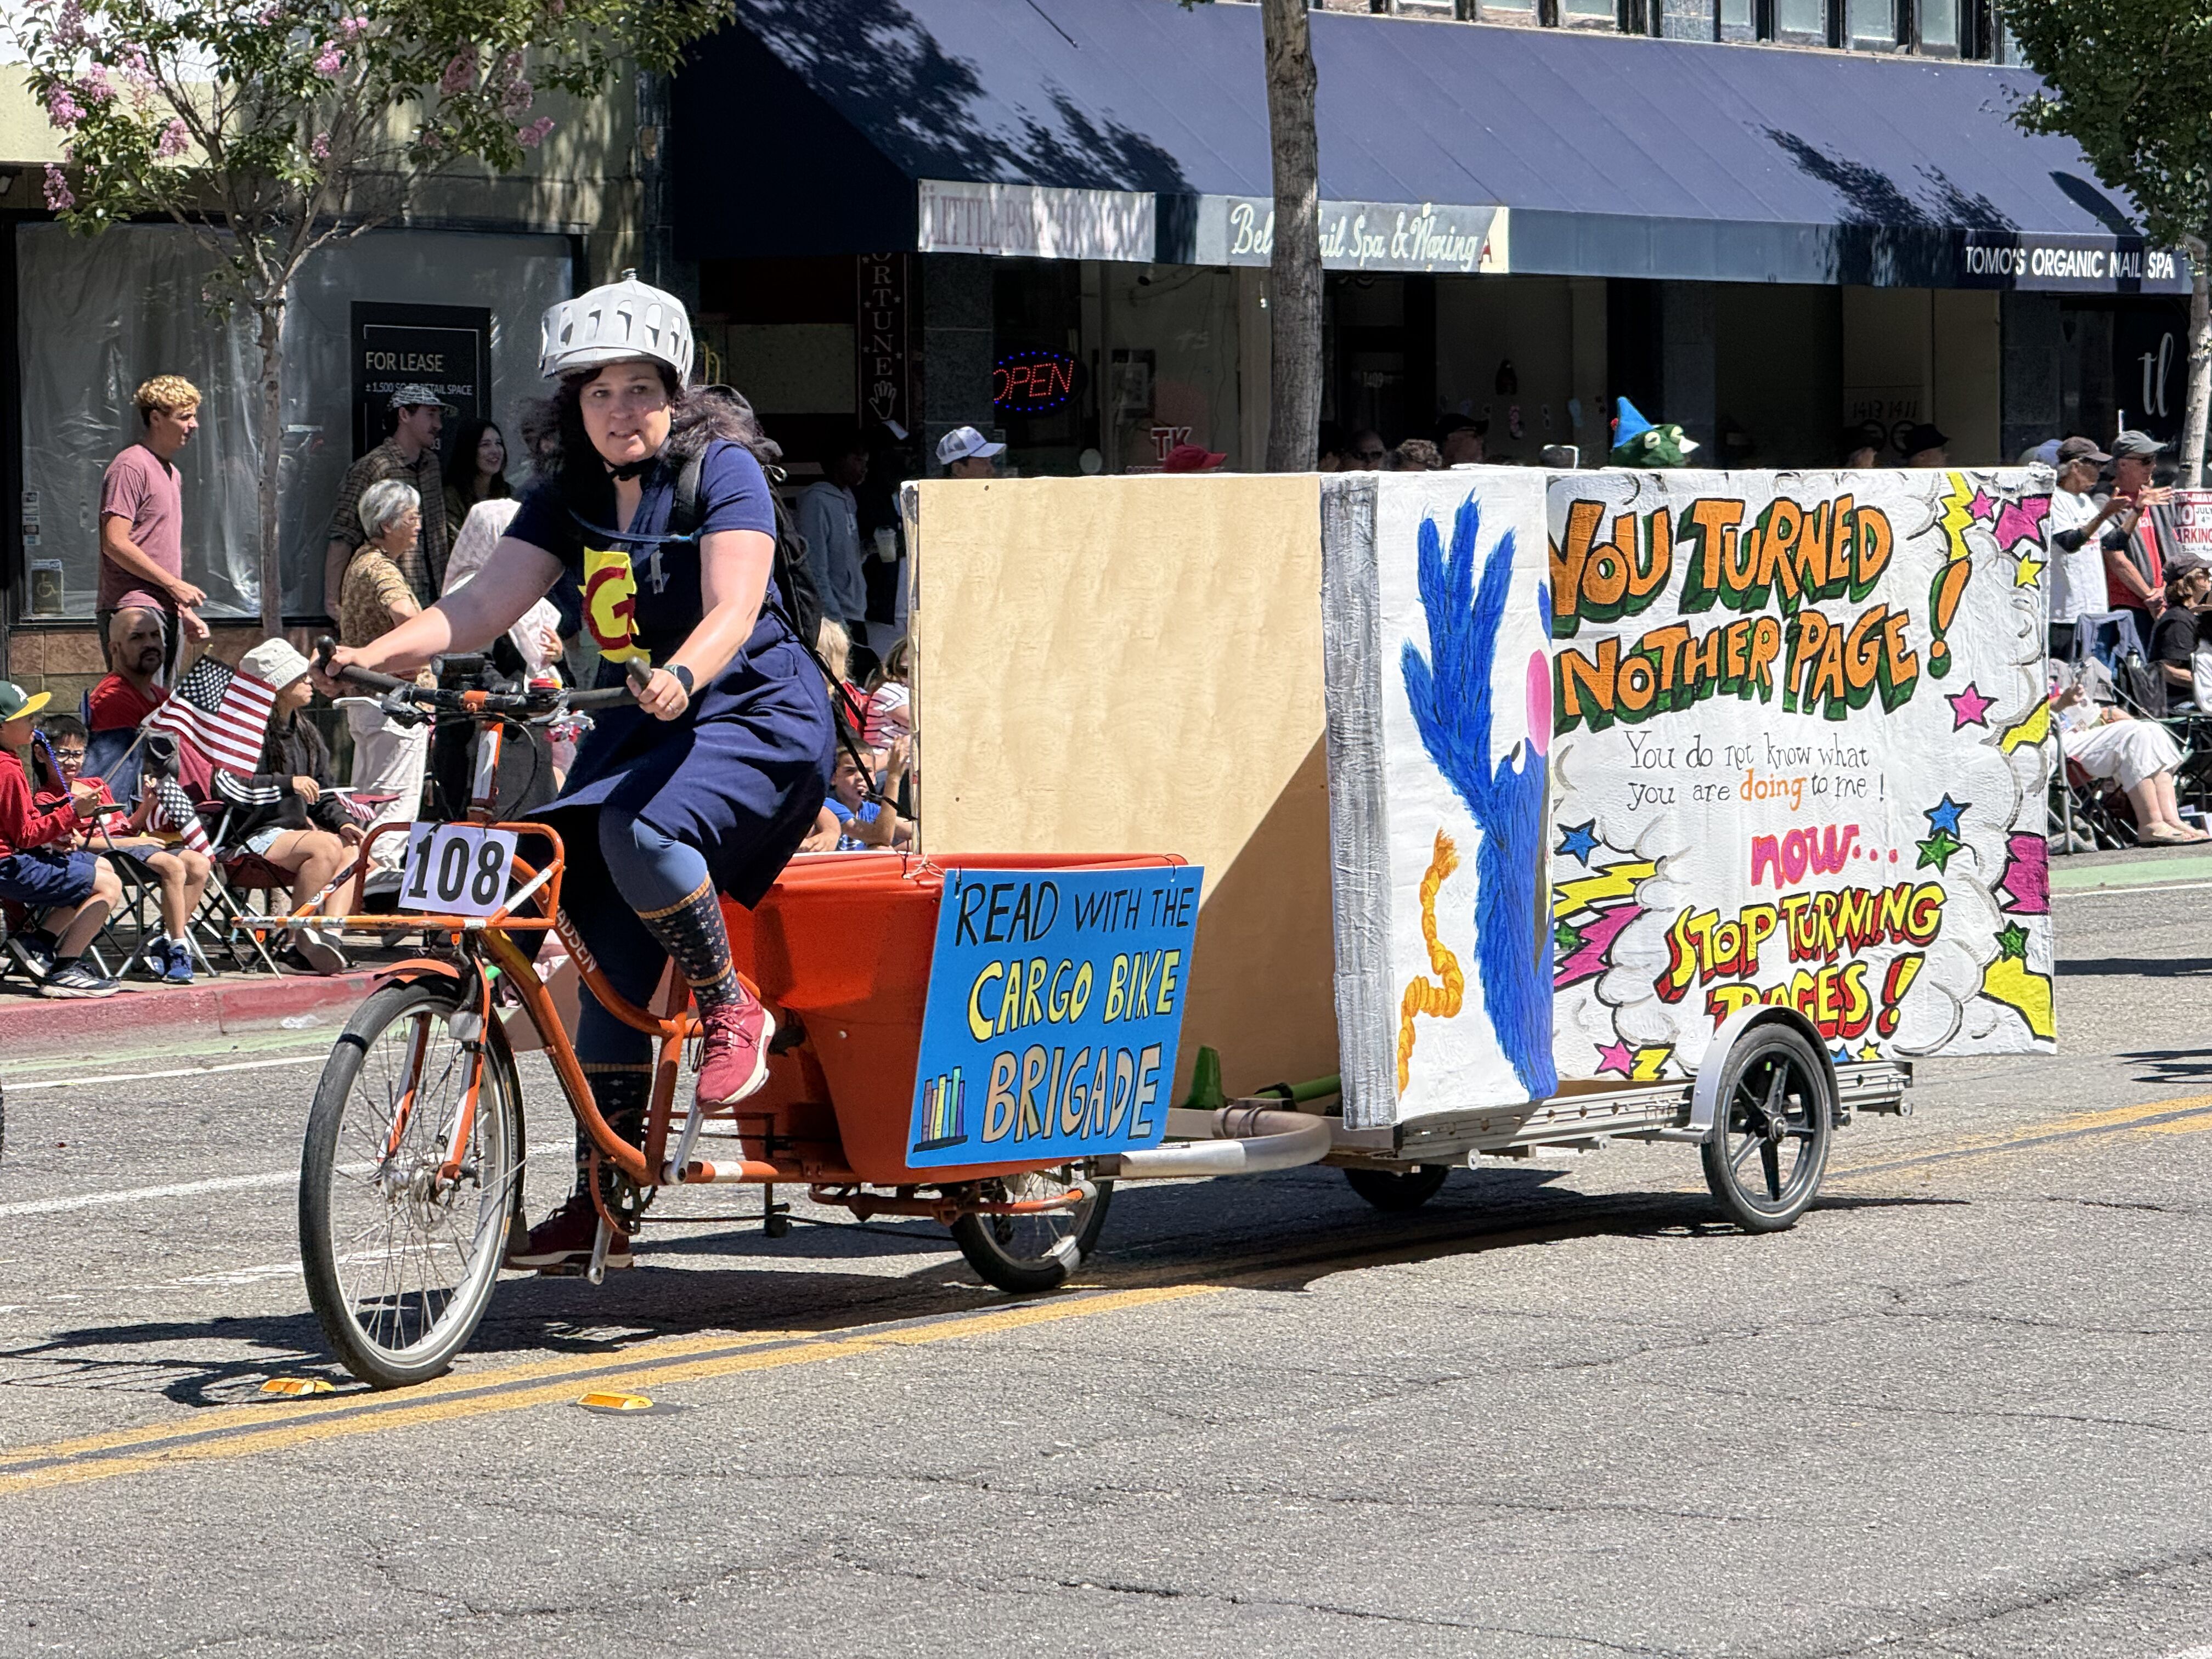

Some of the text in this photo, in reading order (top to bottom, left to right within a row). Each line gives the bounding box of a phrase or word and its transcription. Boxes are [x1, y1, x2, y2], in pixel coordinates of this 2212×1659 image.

[1231, 203, 1480, 271] Bel ail Spa & Waxing
[1966, 246, 2175, 279] TOMO'S ORGANIC NAIL SPA
[366, 352, 444, 372] FOR LEASE
[447, 385, 473, 396] SPACE
[994, 359, 1074, 401] OPEN
[1548, 493, 1893, 639] YOU TURNED
[2177, 528, 2212, 544] ARKING
[583, 566, 636, 650] G
[1553, 615, 1782, 733] NOTHER
[1623, 730, 1870, 770] You do not know what
[1627, 782, 1675, 811] you
[1692, 783, 1731, 803] are
[1740, 768, 1807, 812] doing
[1812, 772, 1828, 795] to
[408, 835, 505, 906] 108
[549, 900, 597, 973] ADSEN
[955, 880, 1194, 947] READ WITH THE
[1653, 881, 1948, 1005] STOP TURNING
[967, 949, 1181, 1043] CARGO BIKE
[981, 1041, 1163, 1144] BRIGADE
